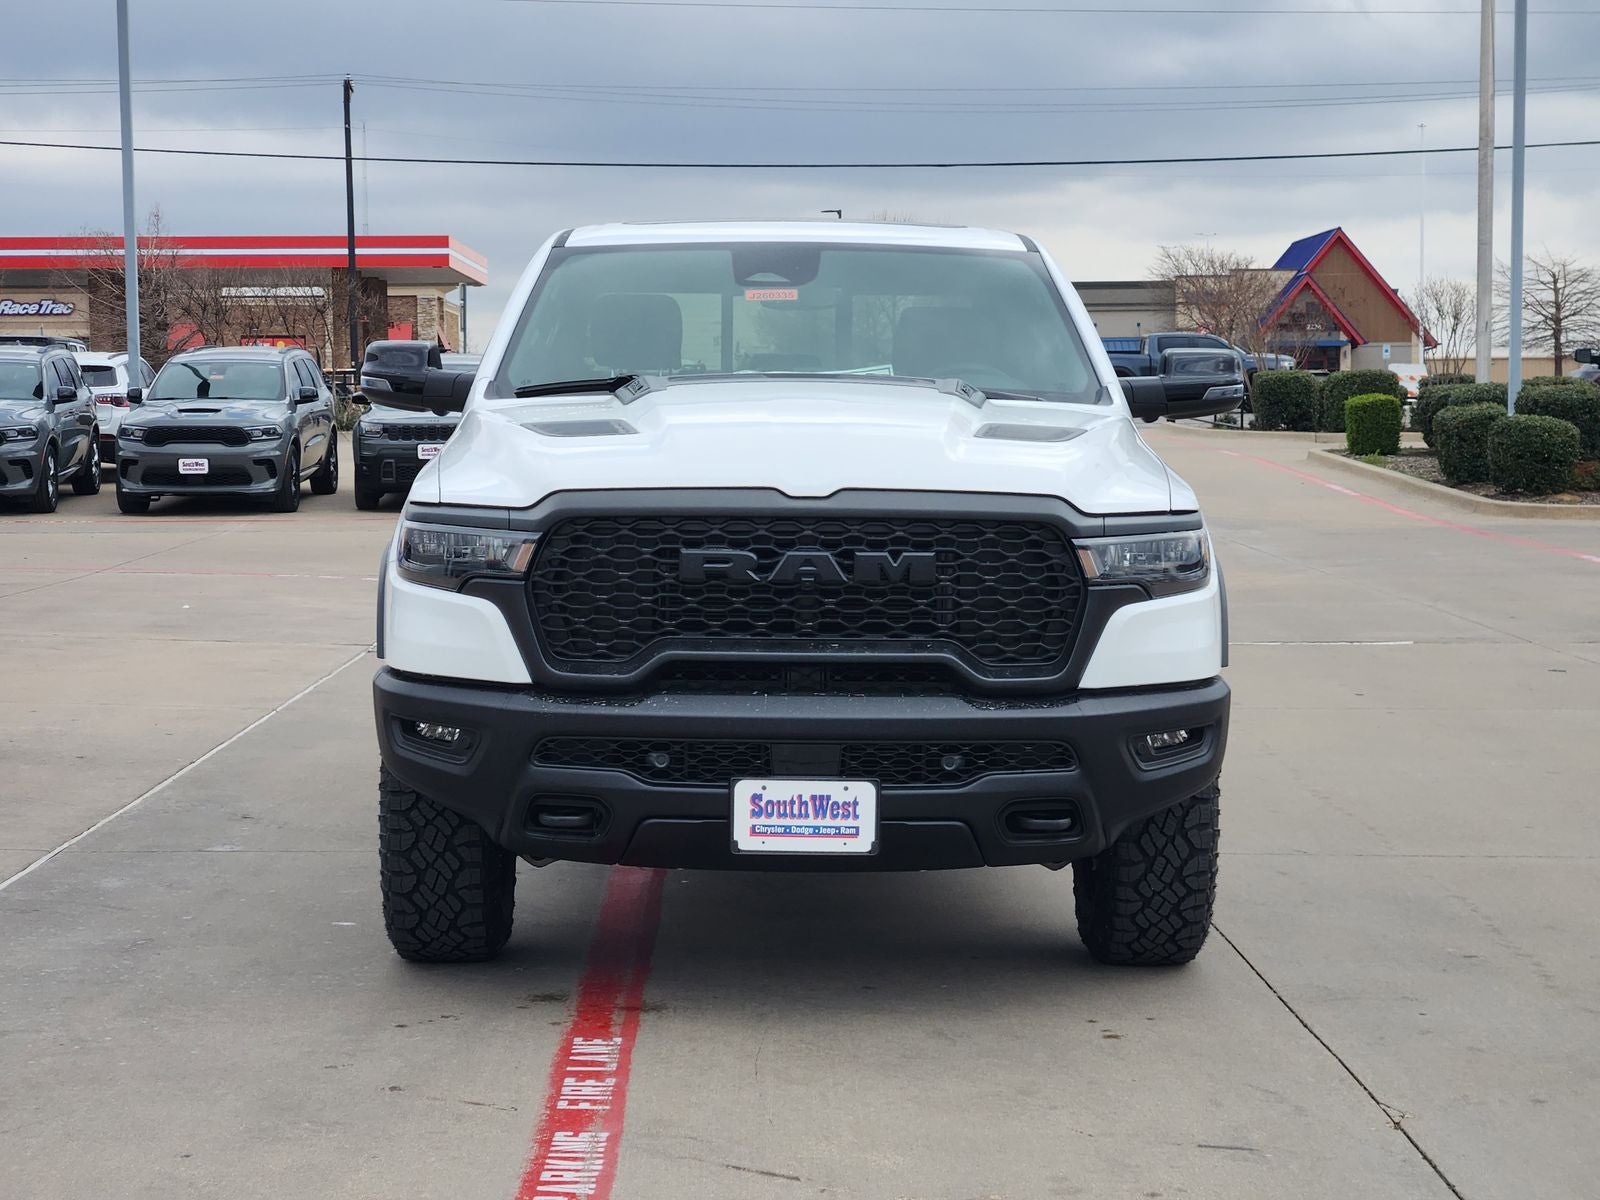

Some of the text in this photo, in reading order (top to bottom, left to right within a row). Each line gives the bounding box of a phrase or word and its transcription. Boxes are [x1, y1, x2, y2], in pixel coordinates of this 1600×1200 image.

[0, 299, 75, 315] RaceTrac
[679, 548, 937, 584] RAM
[749, 792, 860, 821] SouthWest
[755, 825, 856, 835] Chrysler Dodge Jeep Ram
[566, 1037, 622, 1071] LANE
[556, 1077, 616, 1110] FIRE
